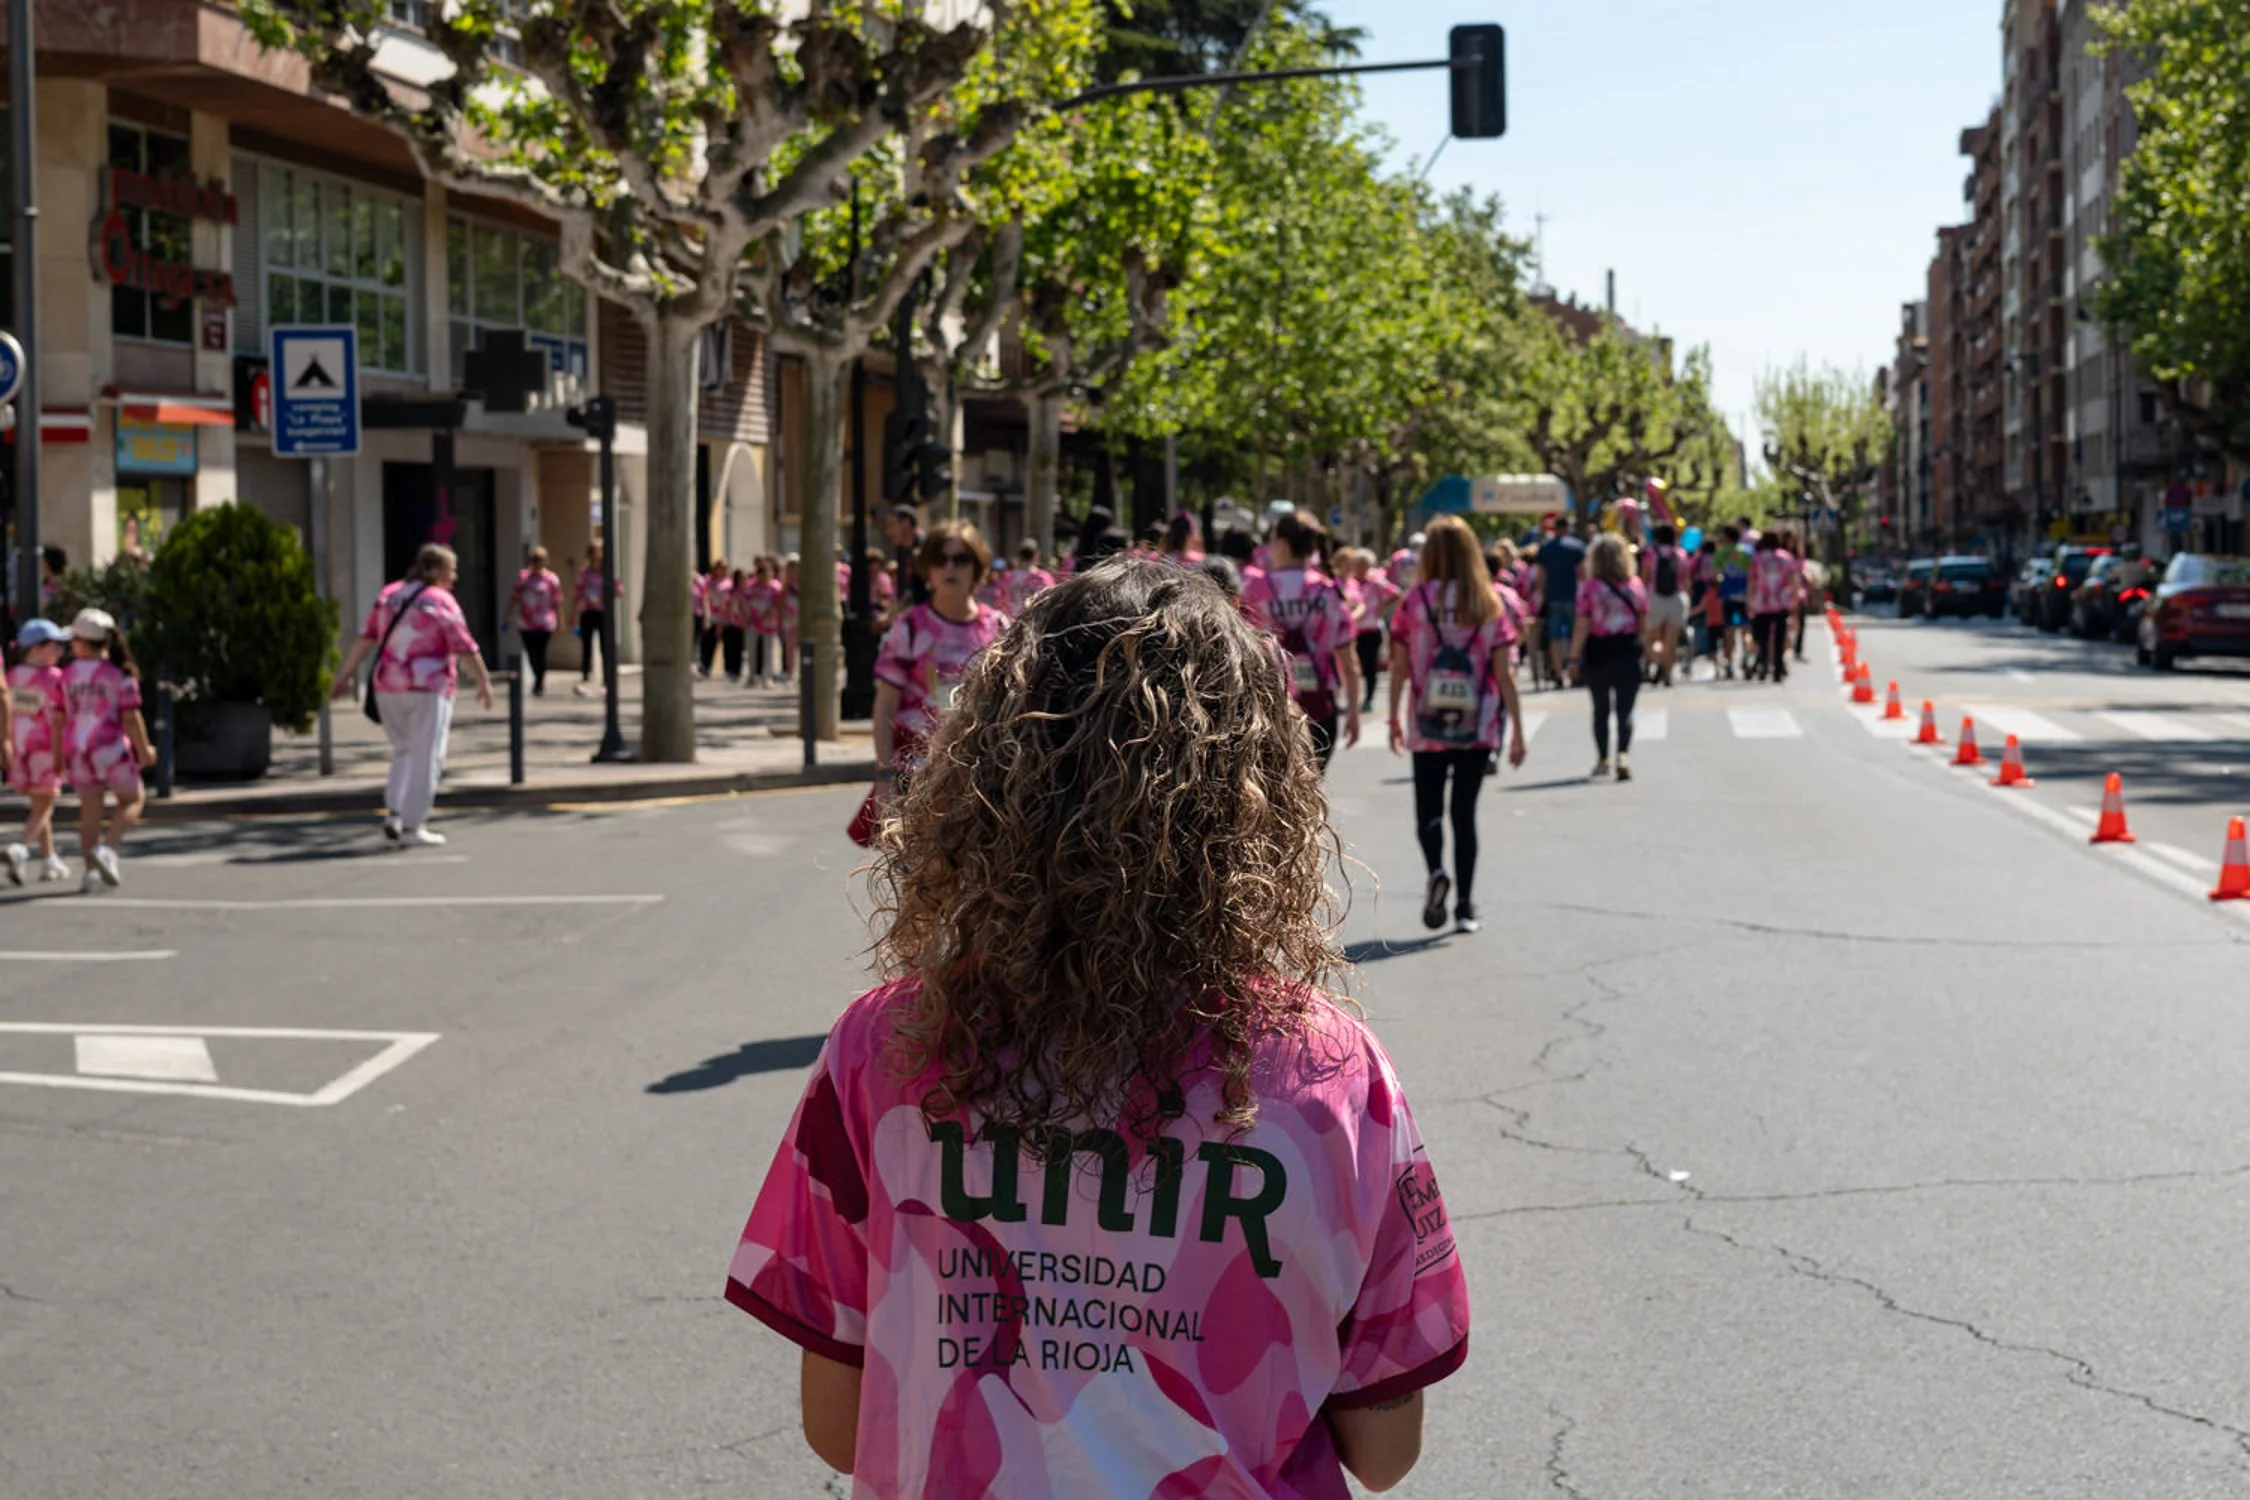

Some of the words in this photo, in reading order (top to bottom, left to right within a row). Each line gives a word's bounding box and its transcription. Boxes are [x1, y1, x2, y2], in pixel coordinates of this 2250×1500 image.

[938, 1247, 1166, 1293] UNIVERSIDAD
[938, 1292, 1205, 1342] INTERNACIONAL
[938, 1337, 981, 1369] DE
[993, 1339, 1031, 1369] LA
[1041, 1339, 1135, 1374] RIOJA
